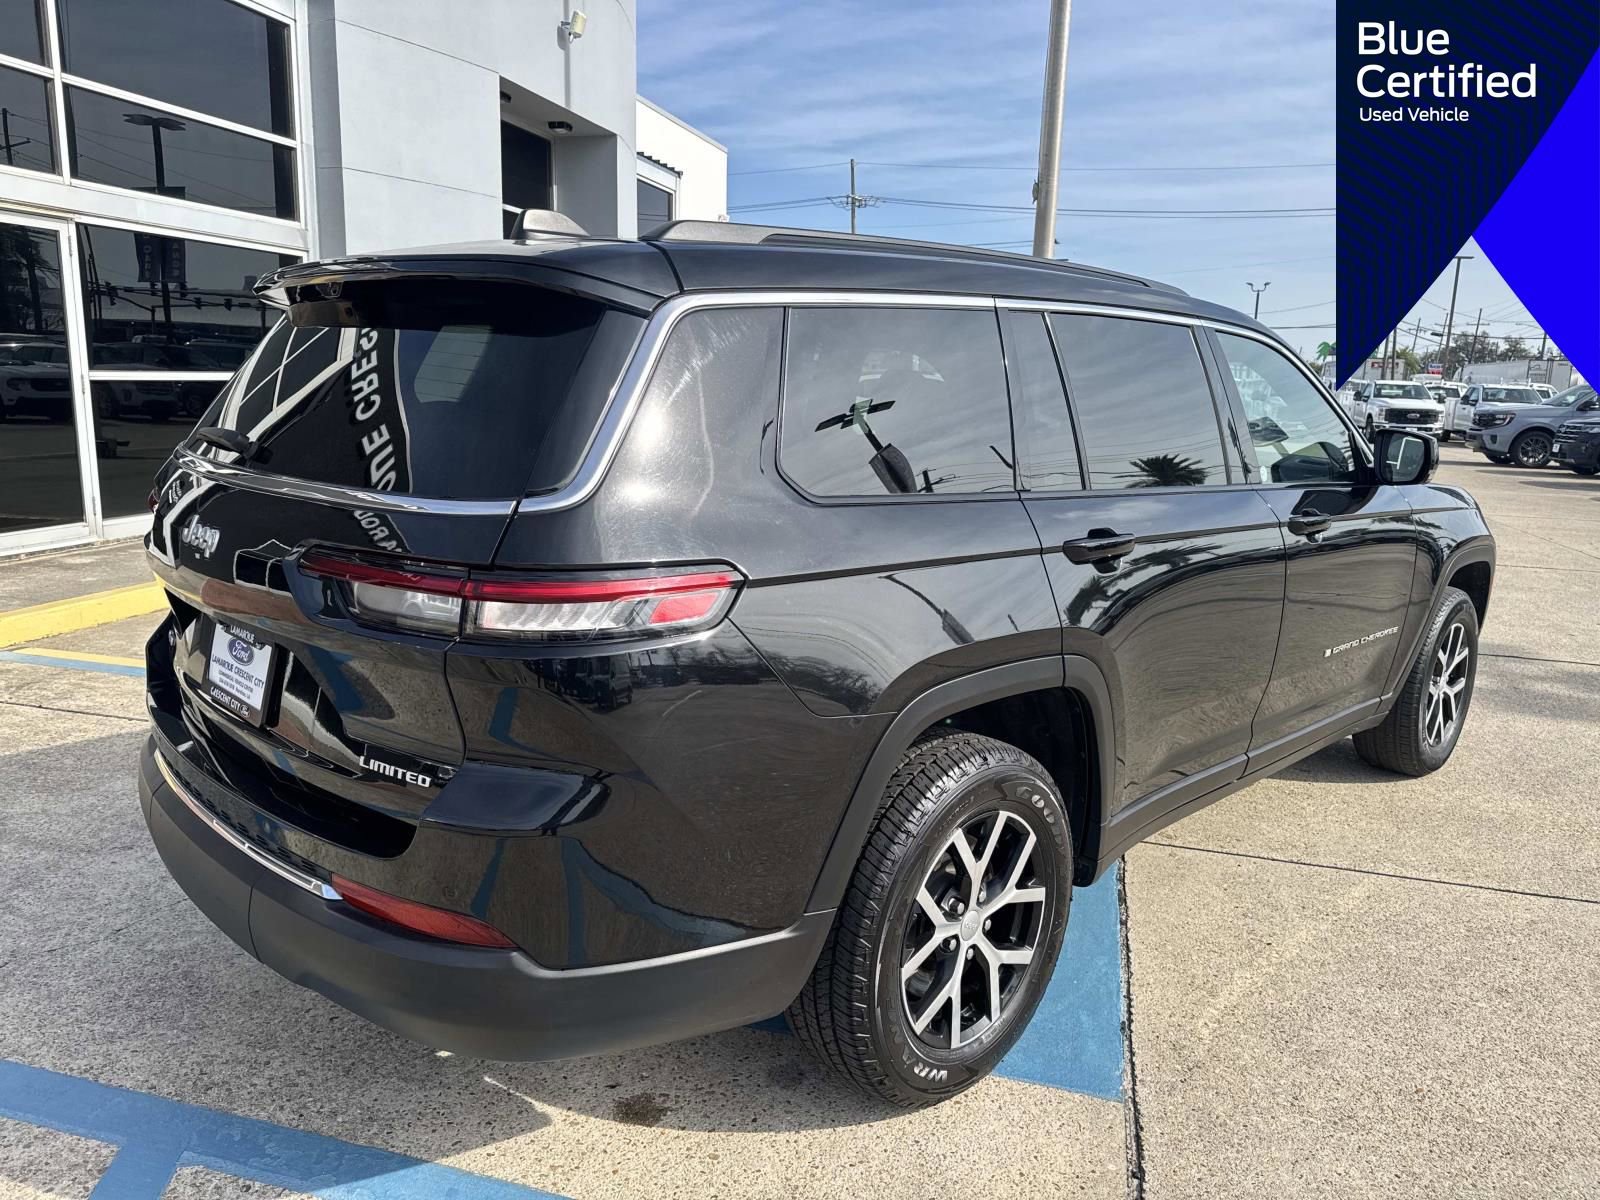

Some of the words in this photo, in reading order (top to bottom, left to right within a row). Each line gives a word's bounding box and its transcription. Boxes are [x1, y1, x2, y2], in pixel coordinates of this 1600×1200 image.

[182, 515, 220, 558] Jeep
[233, 640, 250, 661] Ford
[1333, 640, 1360, 653] GRAND
[253, 677, 264, 688] CITY
[359, 755, 431, 788] LIMITED
